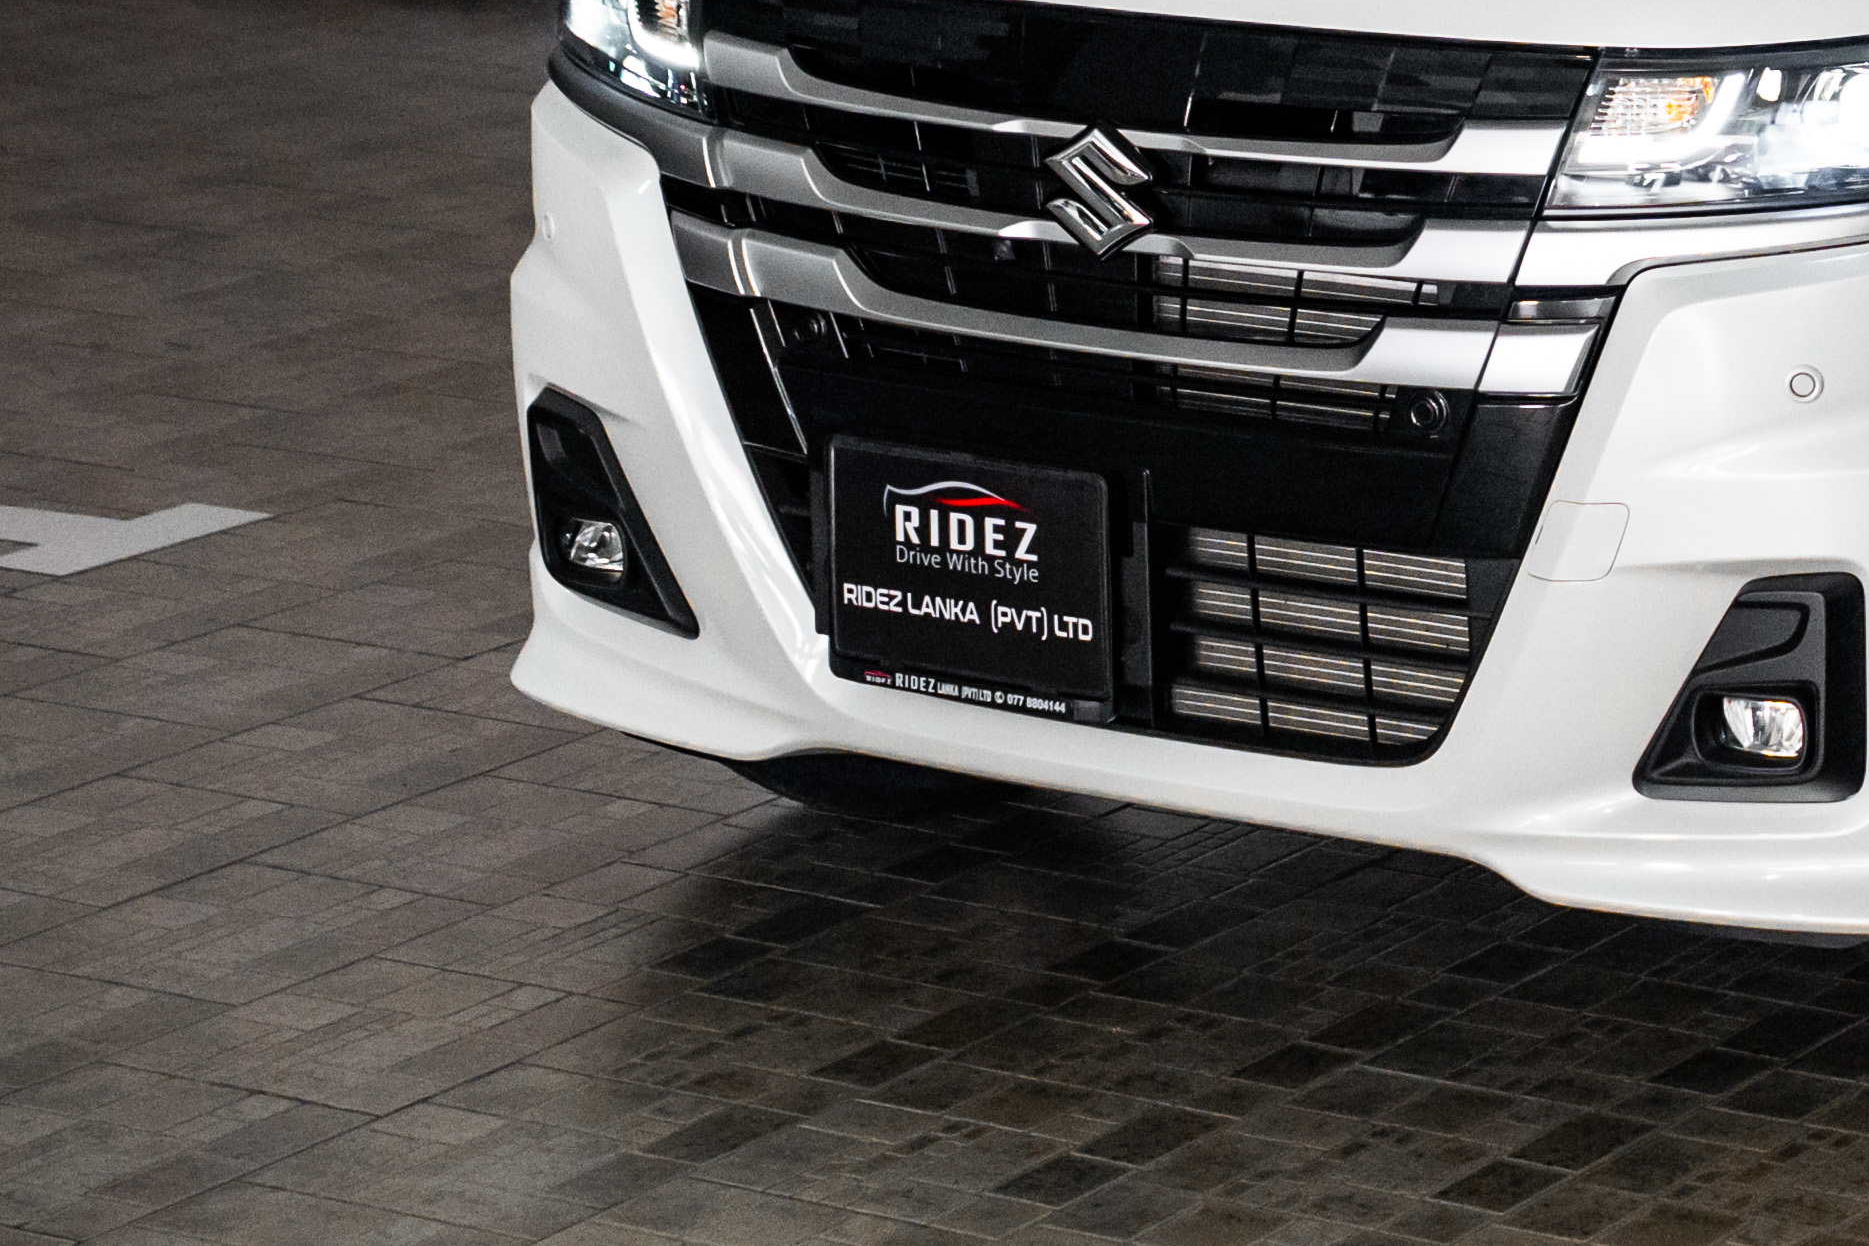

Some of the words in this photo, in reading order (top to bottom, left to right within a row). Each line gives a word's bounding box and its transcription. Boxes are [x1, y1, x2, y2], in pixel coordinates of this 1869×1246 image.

[895, 504, 1038, 561] RIDEZ
[896, 544, 942, 569] Drive
[947, 552, 989, 575] With
[994, 559, 1039, 585] Style
[843, 582, 903, 613] RIDEZ
[907, 592, 980, 625] LANKA
[991, 599, 1048, 641] (PVT)
[1053, 614, 1093, 641] LTD
[895, 672, 935, 693] RIDEZ
